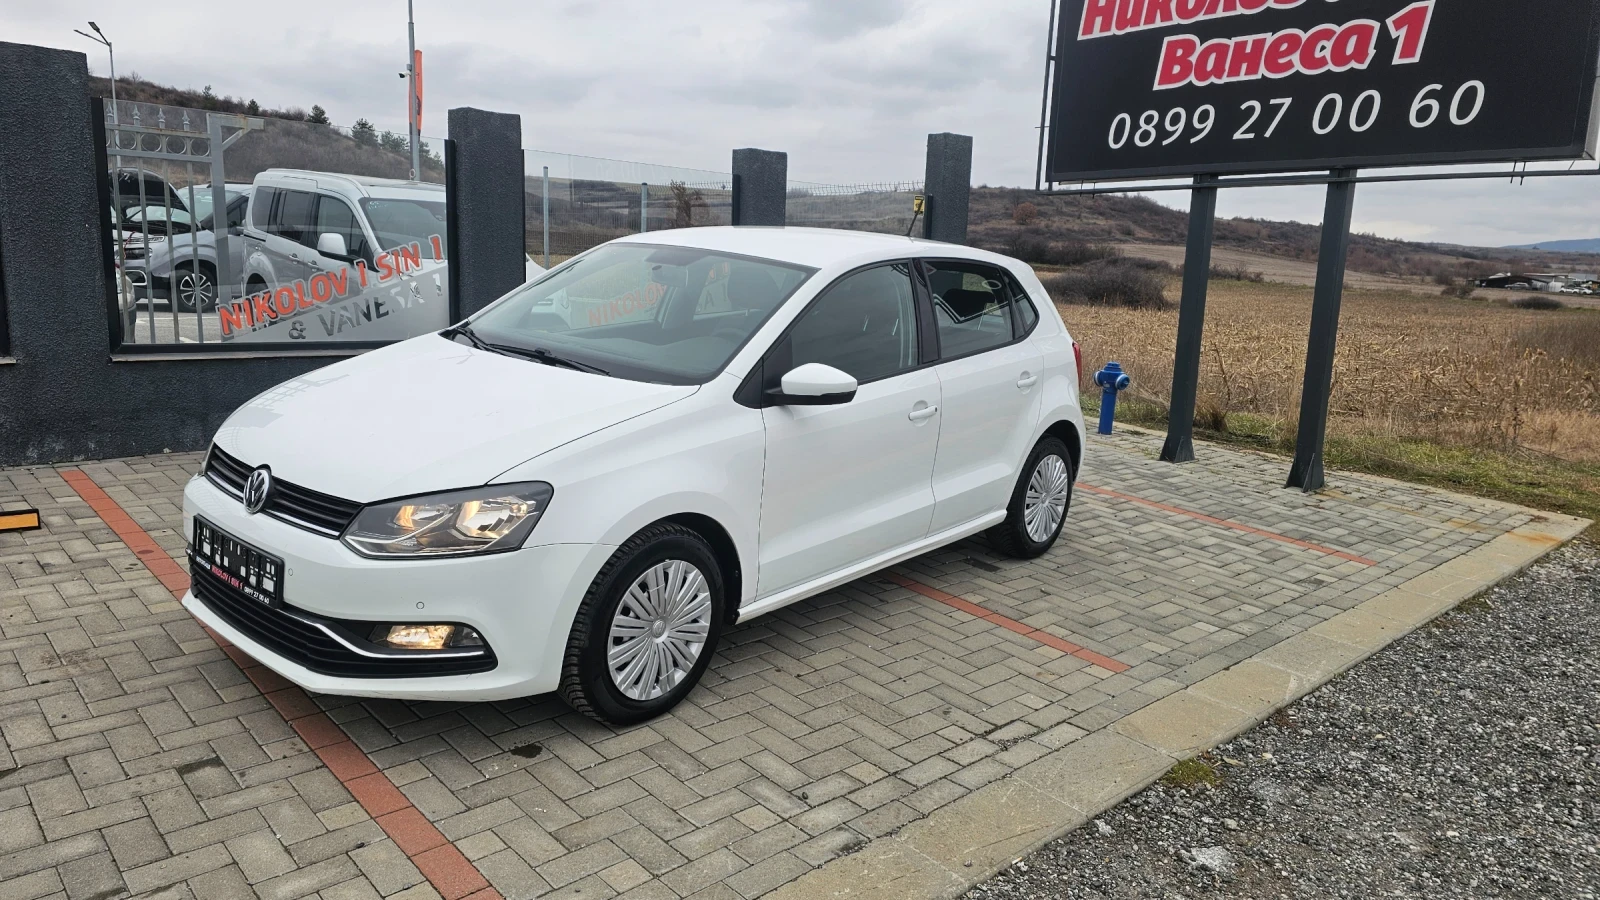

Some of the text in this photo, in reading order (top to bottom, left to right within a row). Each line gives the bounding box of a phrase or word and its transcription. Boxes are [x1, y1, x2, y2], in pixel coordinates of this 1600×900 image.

[1153, 0, 1435, 91] Ванеса 1
[1107, 79, 1485, 149] 0899 27 00 60
[217, 266, 349, 336] NIKOLOV
[355, 260, 369, 288] I
[375, 242, 422, 282] SIN
[288, 319, 307, 339] &
[316, 281, 425, 337] VANESA
